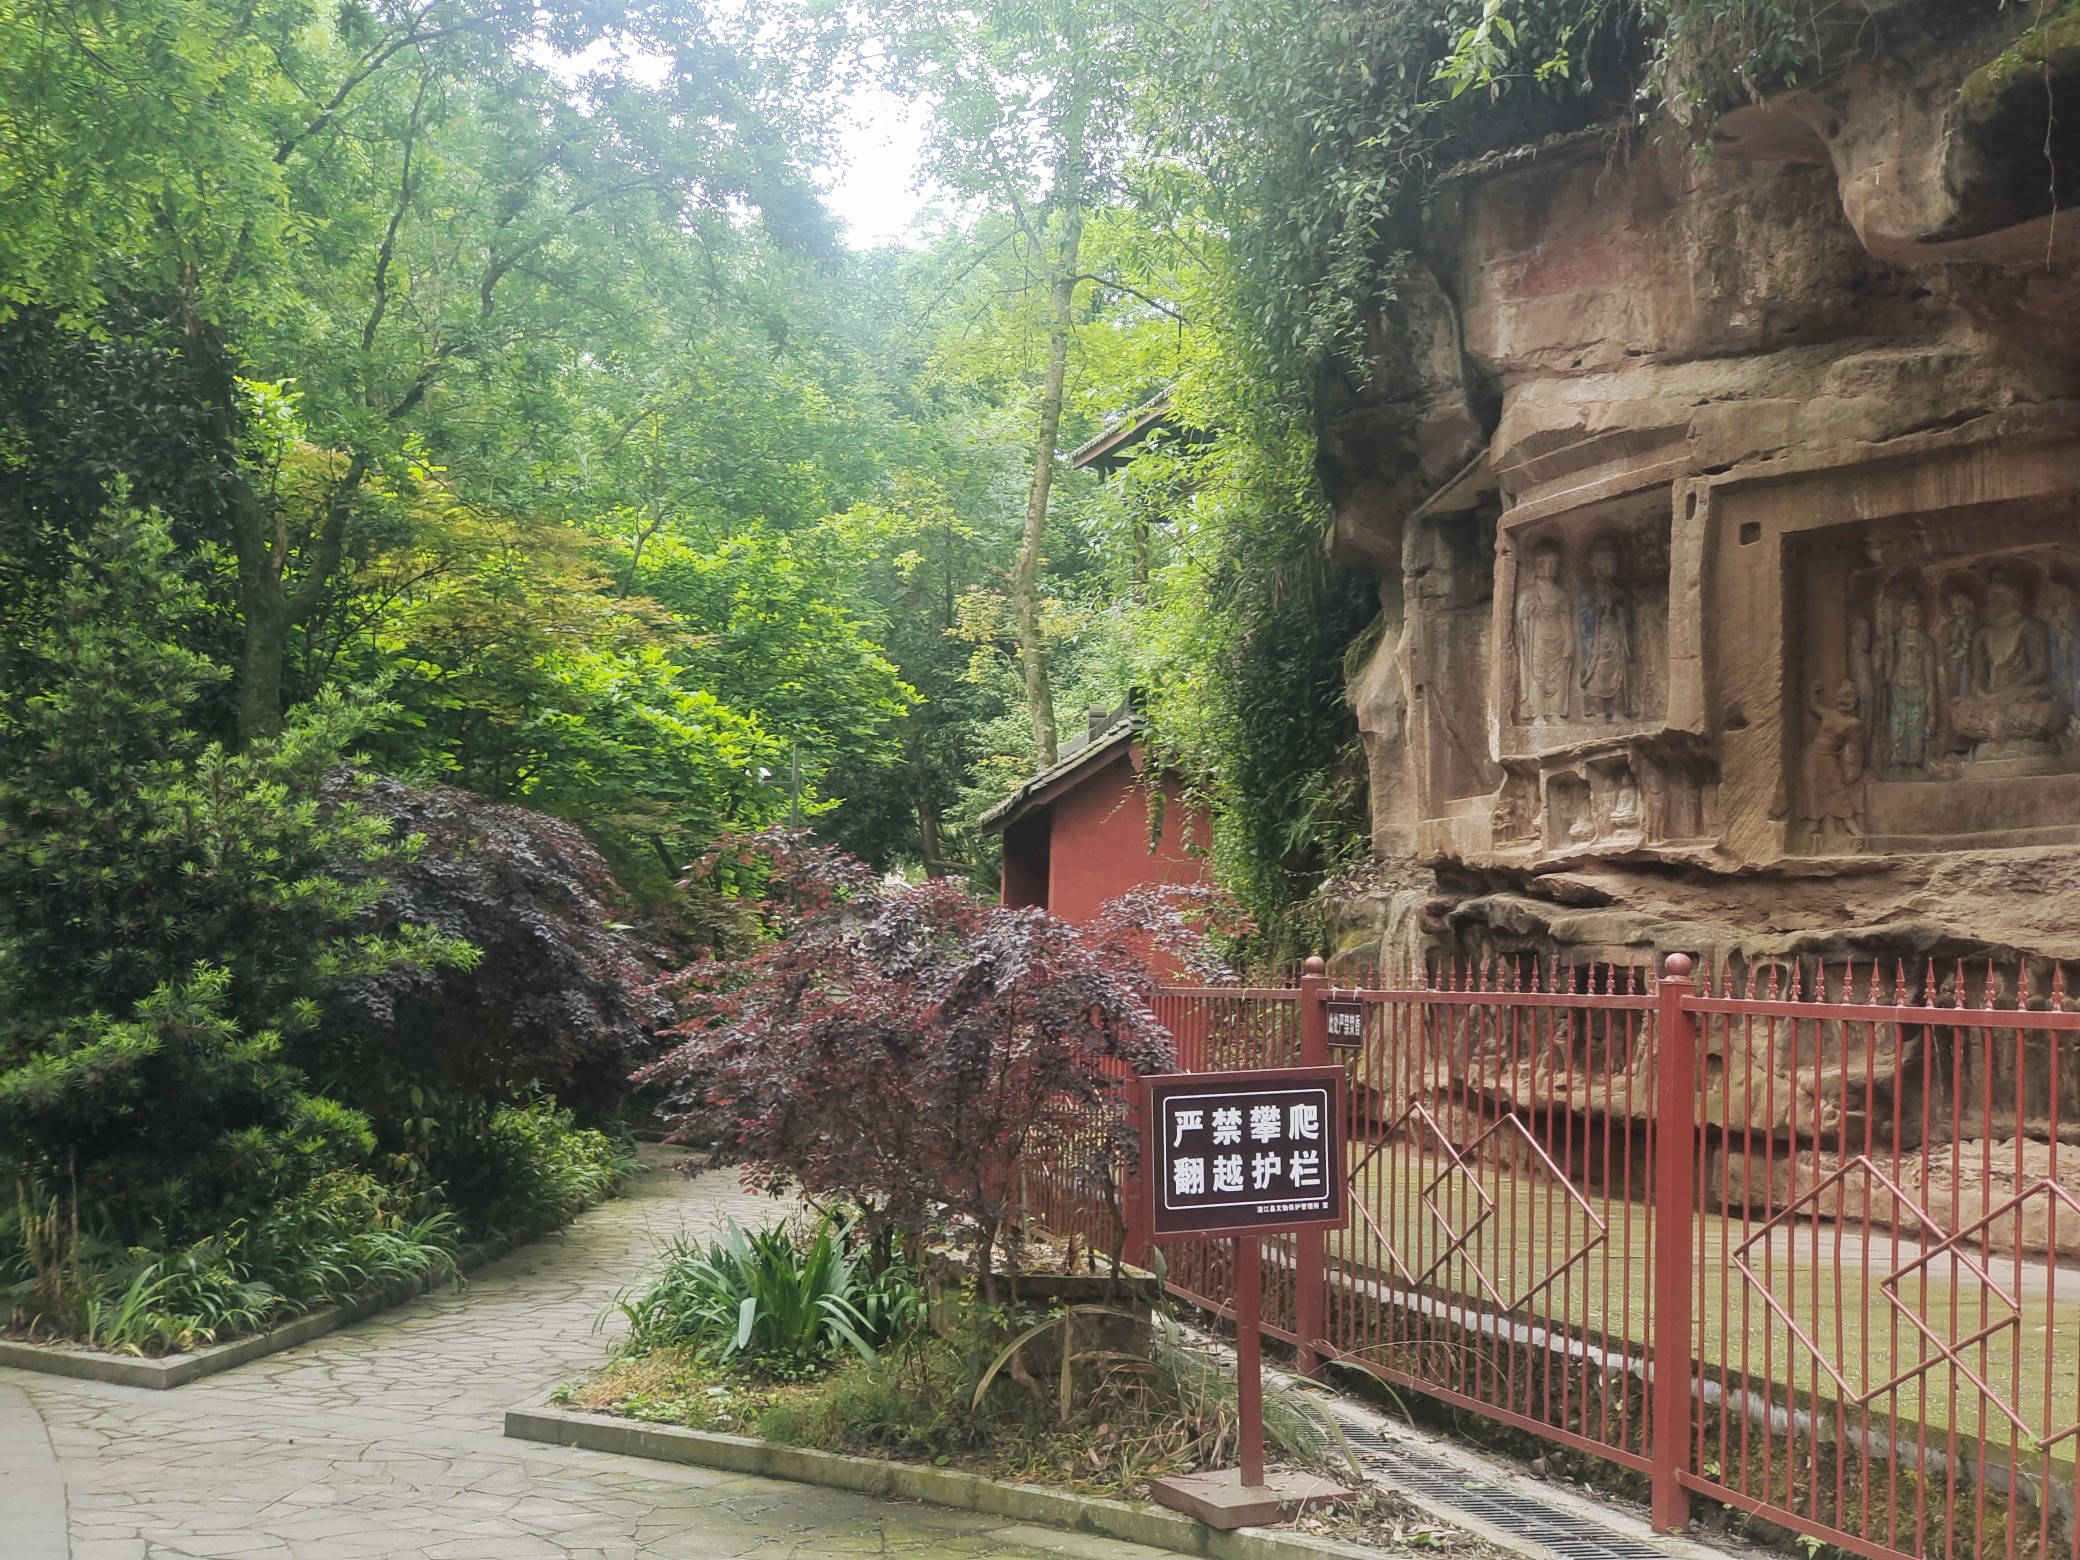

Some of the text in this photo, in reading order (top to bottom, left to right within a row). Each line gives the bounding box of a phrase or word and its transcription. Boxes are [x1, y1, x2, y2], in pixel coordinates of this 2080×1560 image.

[1173, 1103, 1319, 1148] 严禁攀爬
[1173, 1150, 1321, 1195] 翻越护栏
